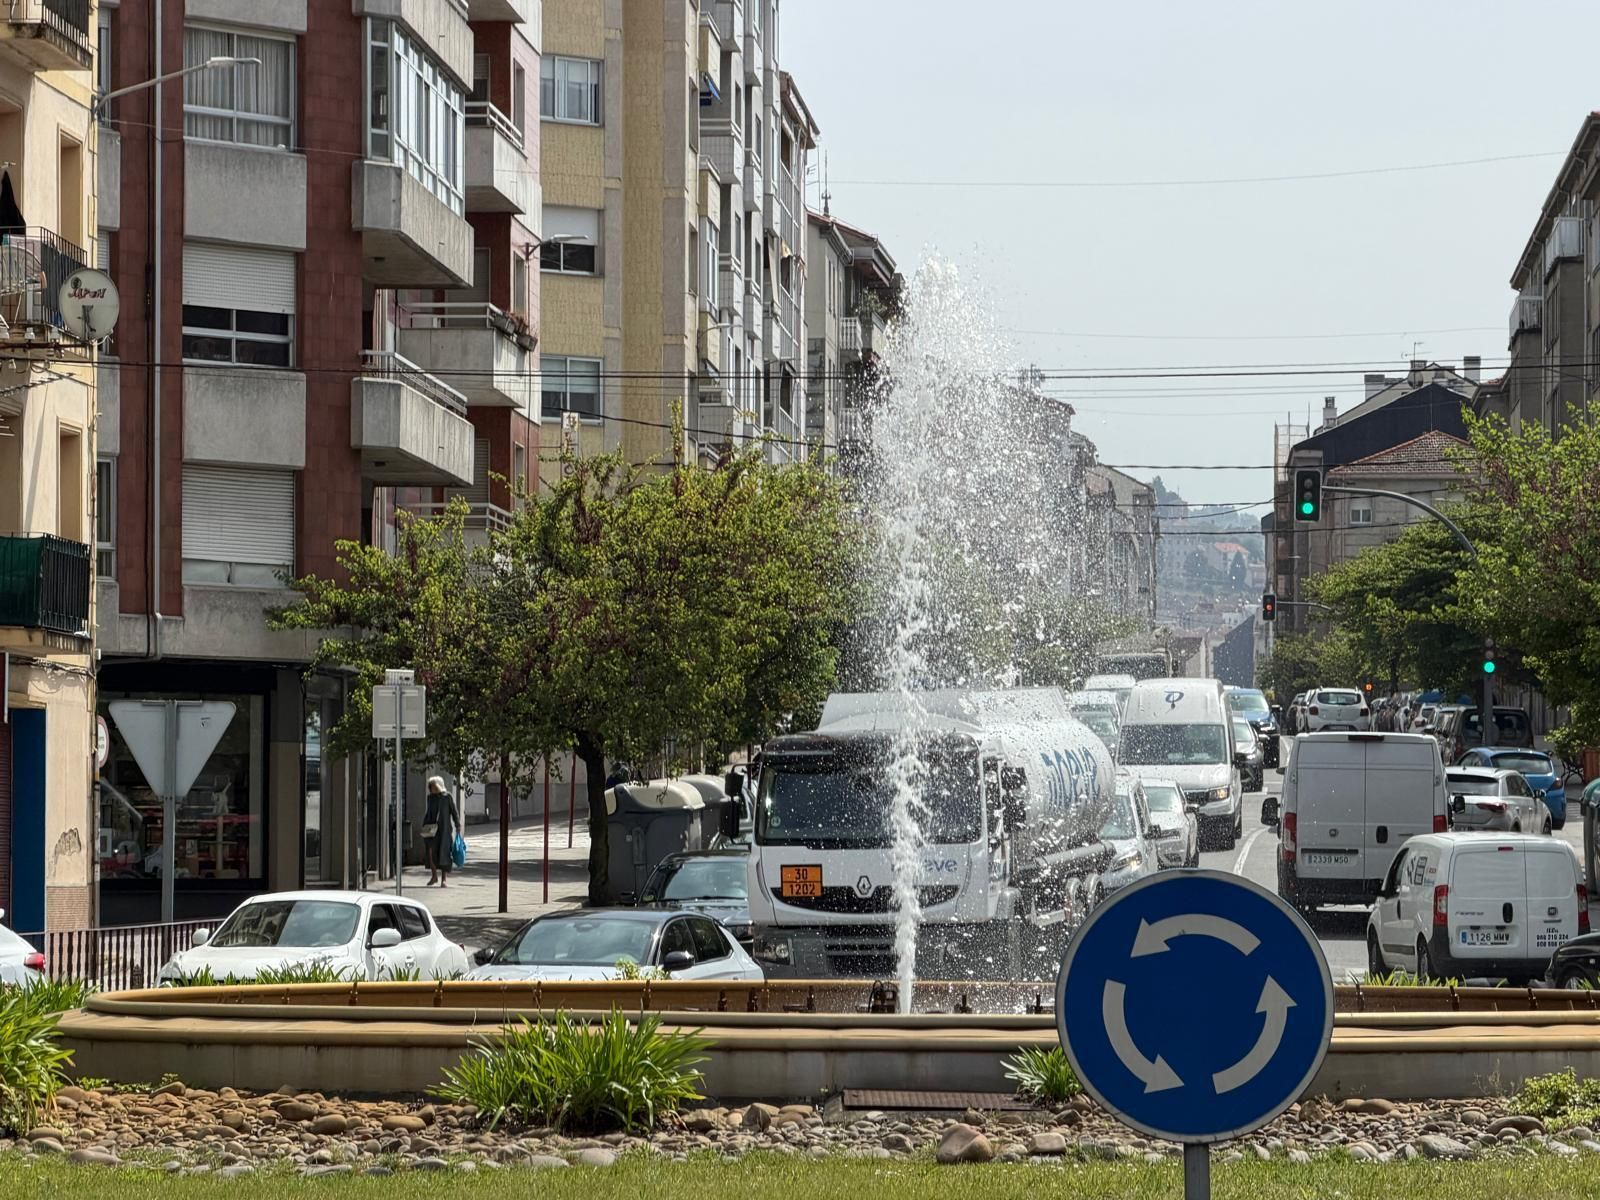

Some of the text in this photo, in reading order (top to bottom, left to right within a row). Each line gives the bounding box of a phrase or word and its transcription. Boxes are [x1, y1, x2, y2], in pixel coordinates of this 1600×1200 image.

[794, 868, 808, 880] 30
[789, 883, 816, 896] 1202
[1470, 932, 1492, 942] 1126
